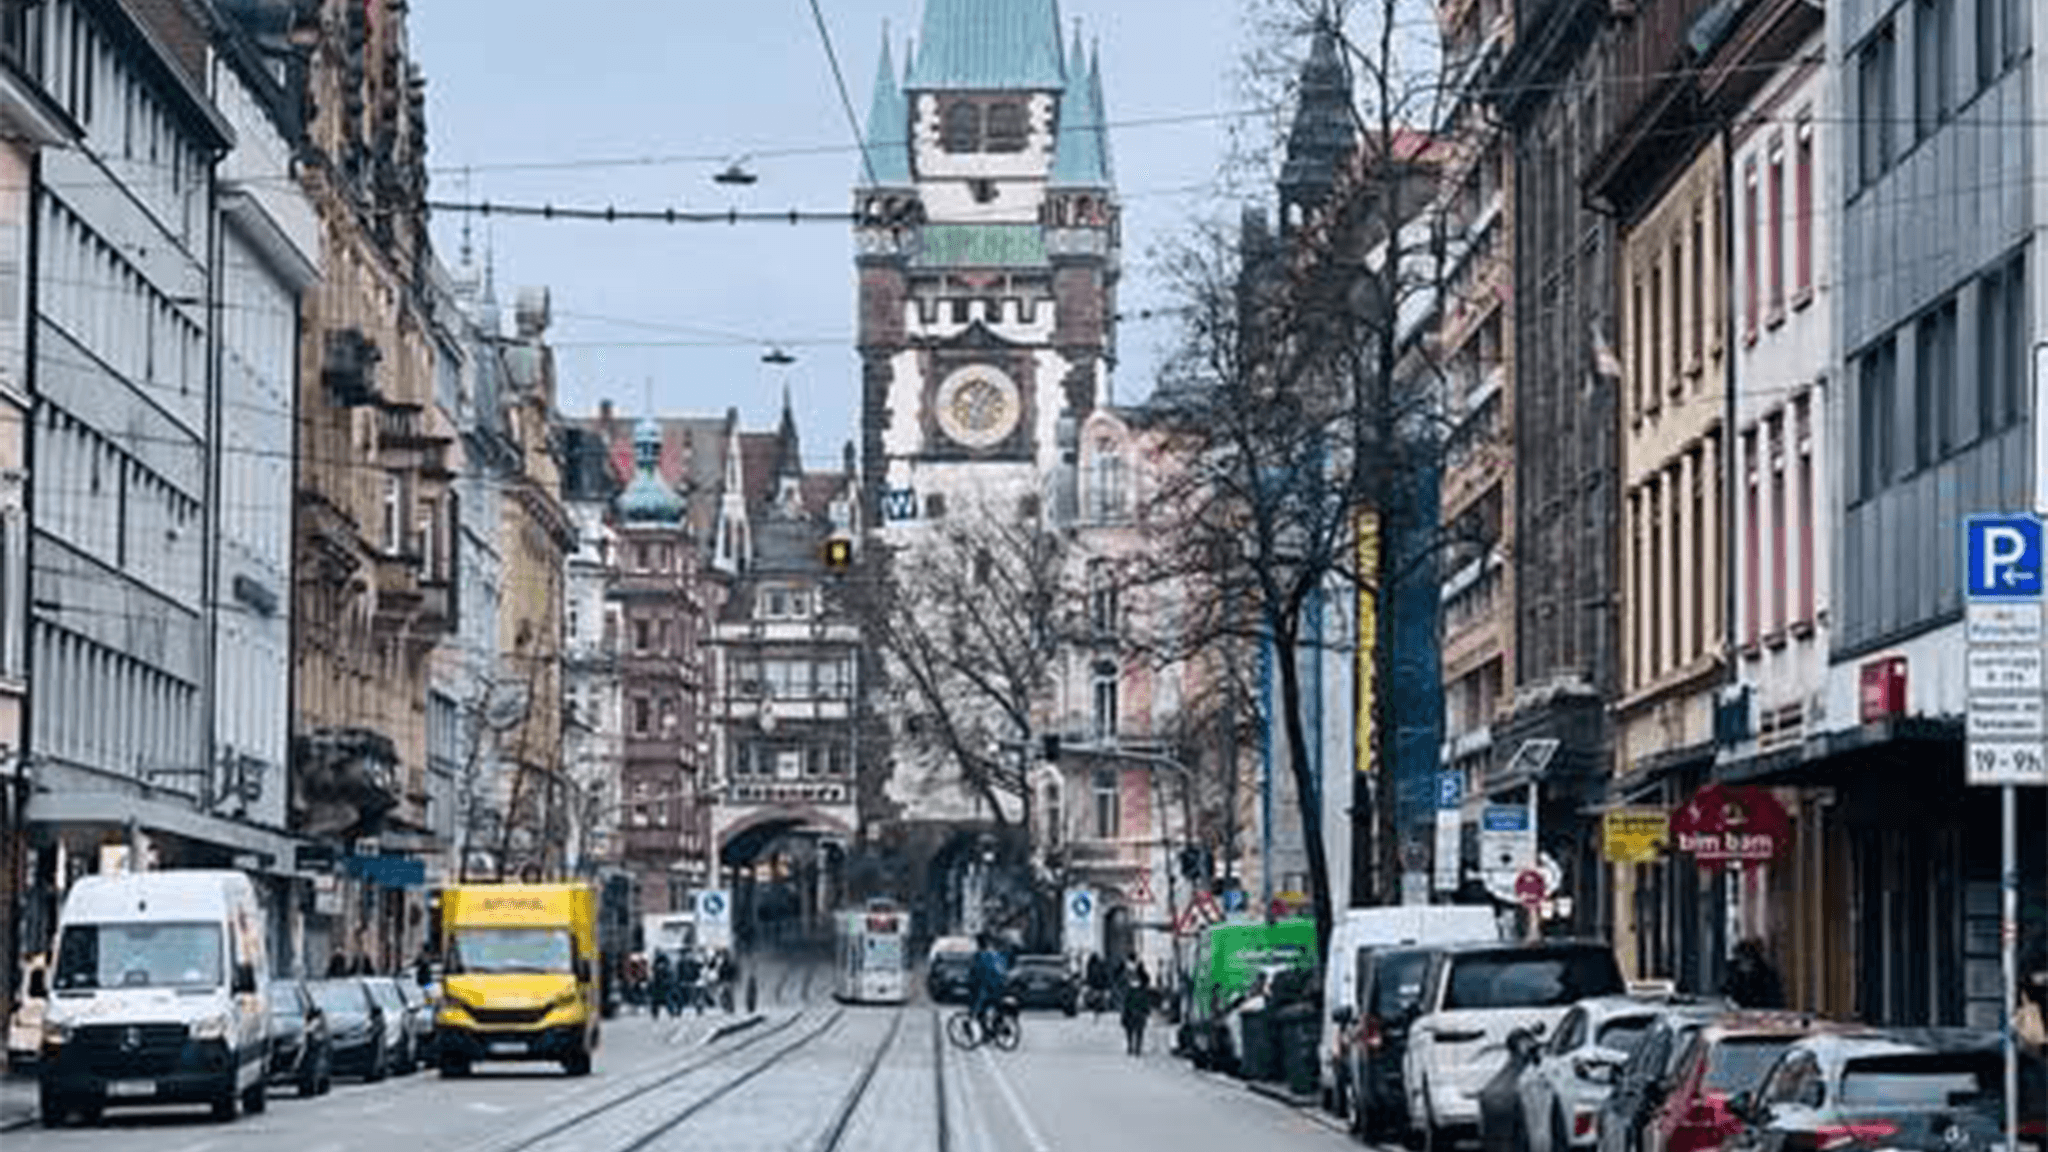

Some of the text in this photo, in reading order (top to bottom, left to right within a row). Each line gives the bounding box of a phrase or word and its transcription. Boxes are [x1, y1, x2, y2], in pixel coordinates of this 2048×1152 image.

[1983, 526, 2026, 589] P
[1975, 750, 1996, 772] 19
[2013, 750, 2042, 772] 9h
[1441, 779, 1458, 805] P
